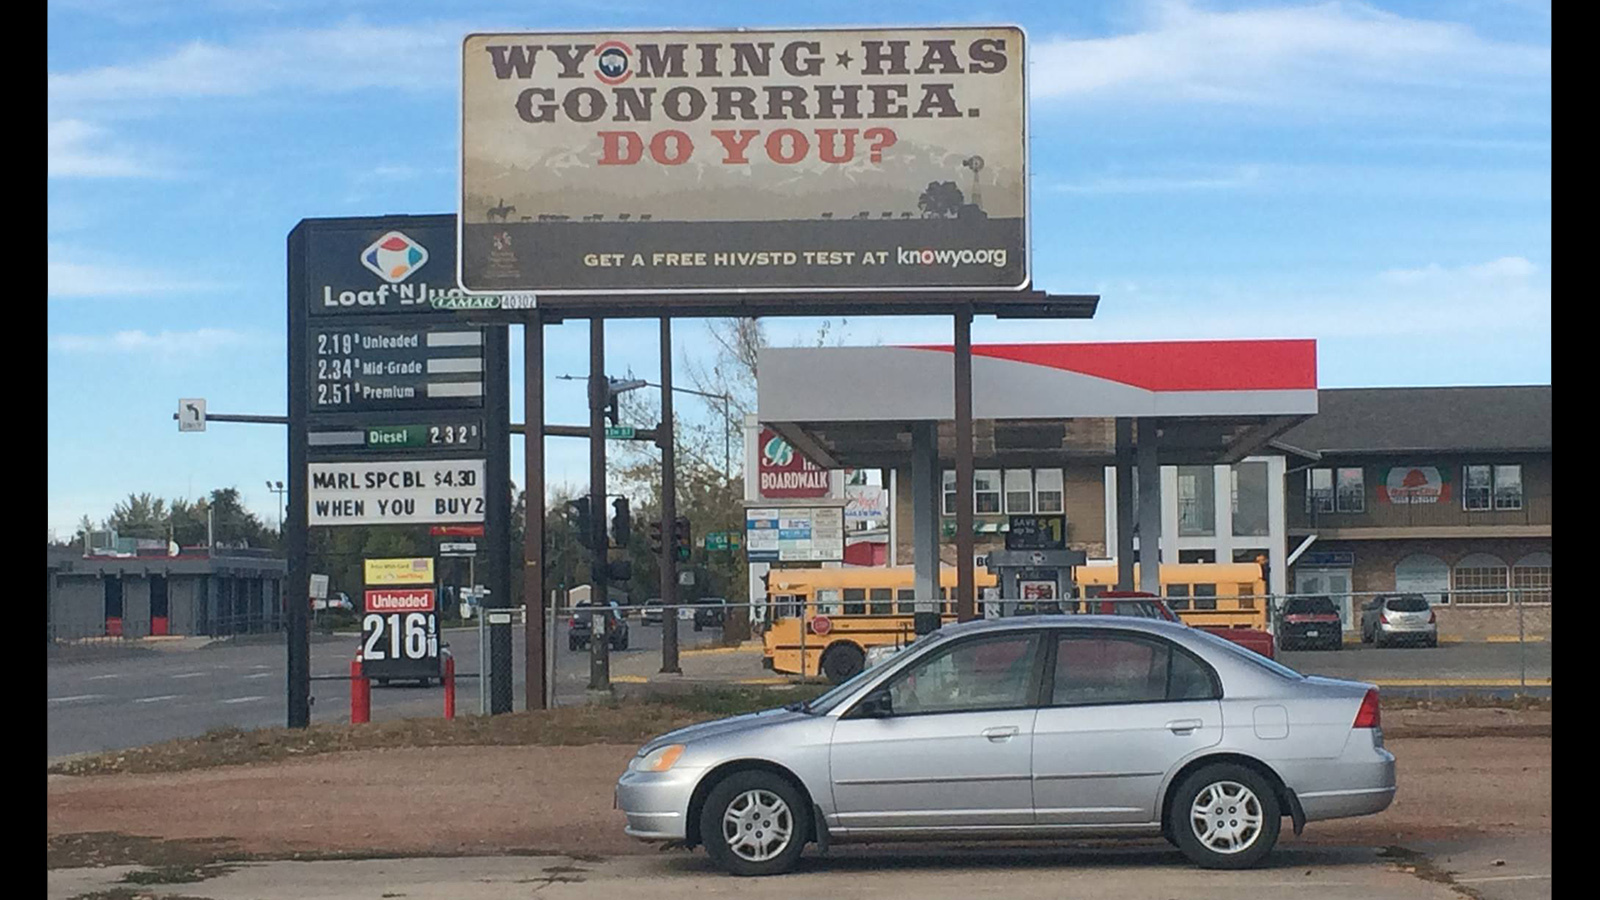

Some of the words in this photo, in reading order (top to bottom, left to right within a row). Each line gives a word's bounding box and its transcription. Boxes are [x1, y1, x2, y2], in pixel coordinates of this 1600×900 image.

[485, 41, 825, 85] WYOMING
[861, 39, 1007, 75] HAS
[515, 84, 980, 123] GONORRHEA.
[597, 130, 695, 165] DO
[711, 127, 898, 164] YOU?
[584, 253, 625, 267] GET
[631, 253, 645, 267] A
[652, 253, 707, 266] FREE
[714, 252, 797, 265] HIV/STD
[803, 251, 855, 264] TEST
[862, 251, 889, 264] AT
[897, 246, 1007, 268] knowyo.org
[324, 284, 389, 306] Loaf
[438, 296, 494, 308] LAMAR
[363, 334, 418, 349] Unleaded
[318, 359, 352, 379] 2.34
[363, 361, 422, 375] Mid-Grade
[318, 383, 351, 404] 2.51
[363, 385, 414, 399] Premium
[370, 429, 407, 443] Diesel
[313, 472, 360, 489] MARL
[434, 470, 475, 486] $4.30
[761, 471, 828, 490] BOARDWALK
[317, 499, 364, 516] WHEN
[377, 499, 415, 515] YOU
[436, 498, 471, 515] BUY
[475, 498, 485, 514] 2
[1014, 518, 1036, 526] SAVE
[372, 593, 428, 609] Unleaded
[363, 612, 426, 660] 216
